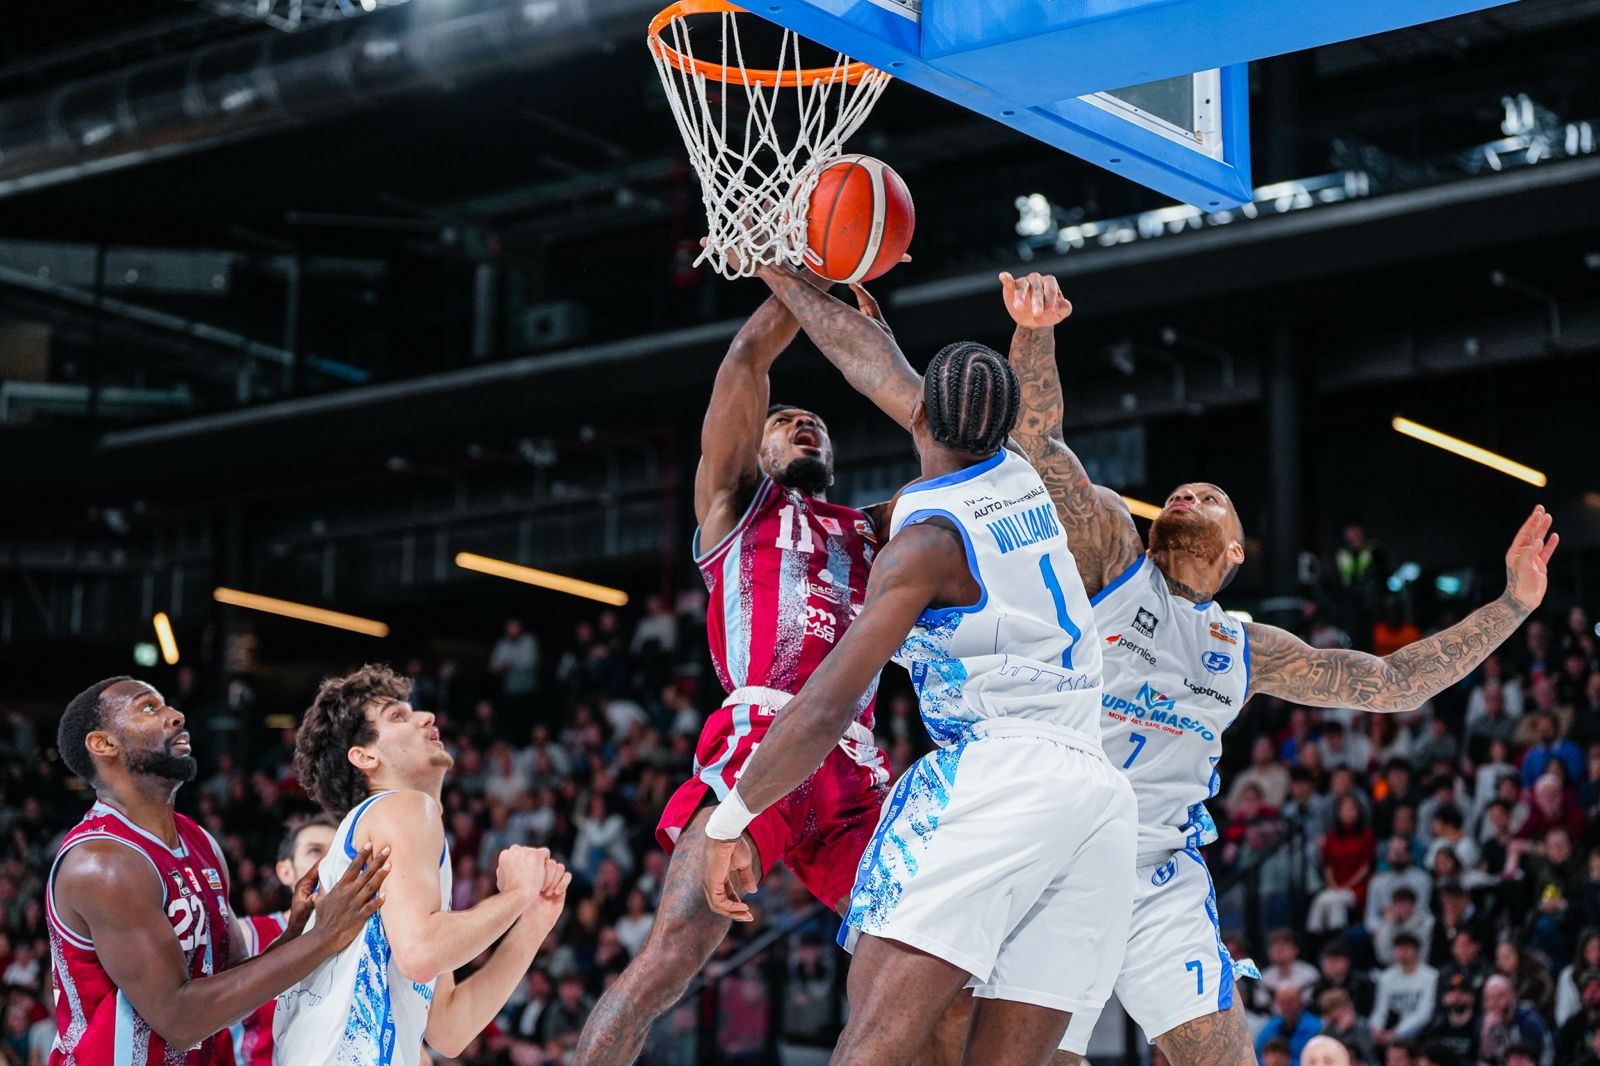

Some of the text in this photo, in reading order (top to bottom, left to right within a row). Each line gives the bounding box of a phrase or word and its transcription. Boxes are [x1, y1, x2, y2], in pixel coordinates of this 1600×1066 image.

[776, 504, 815, 553] 11
[974, 501, 1002, 520] AUTO
[986, 503, 1060, 554] WILLIAMS
[1039, 553, 1081, 670] 1
[804, 627, 836, 644] LOG
[1122, 732, 1147, 769] 7
[168, 894, 207, 951] 22
[1185, 960, 1204, 996] 7
